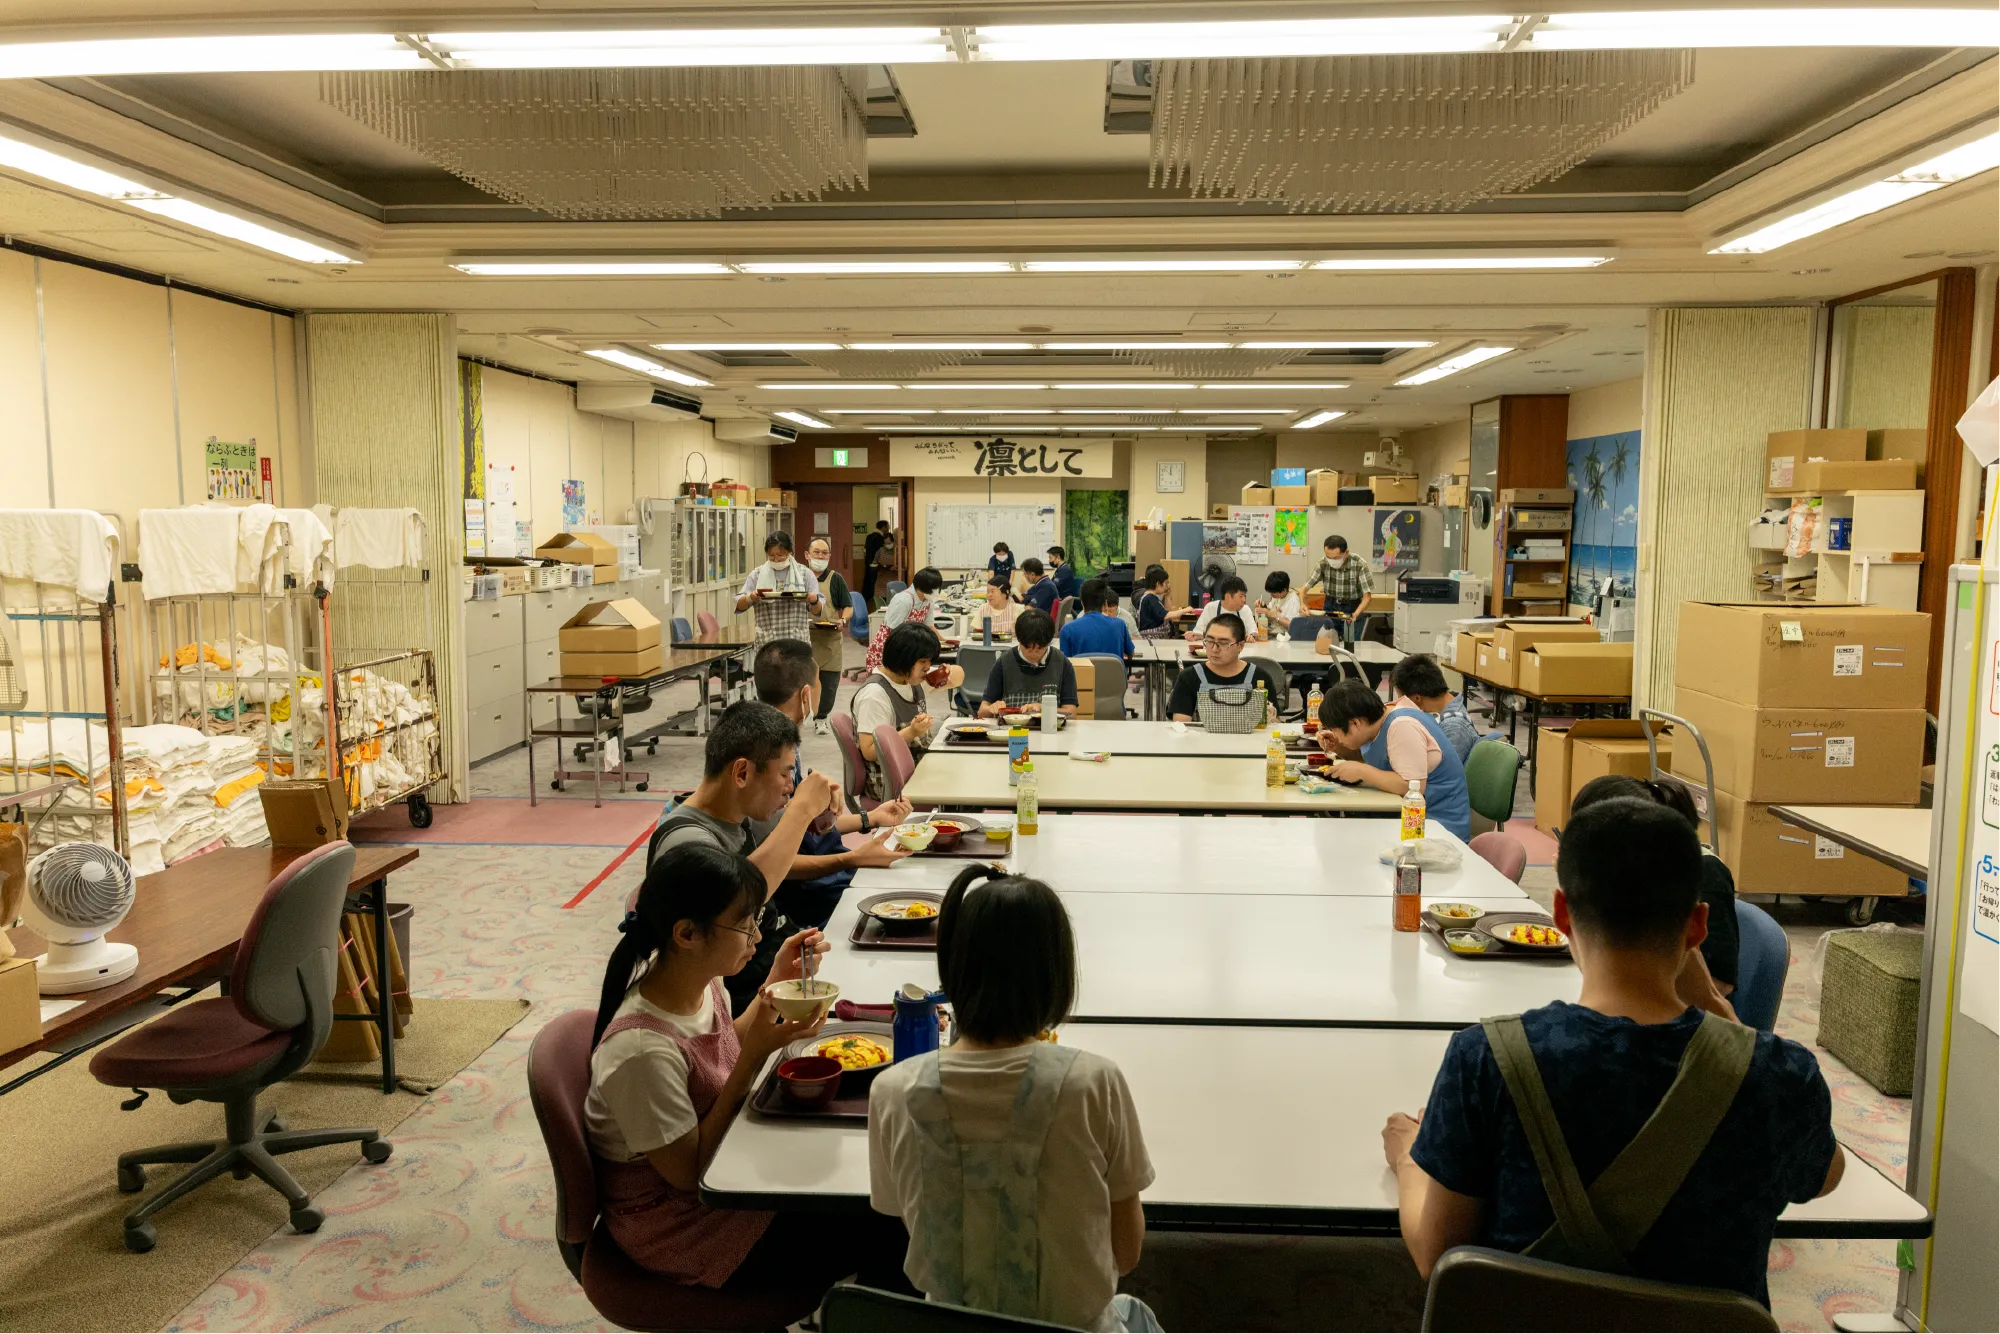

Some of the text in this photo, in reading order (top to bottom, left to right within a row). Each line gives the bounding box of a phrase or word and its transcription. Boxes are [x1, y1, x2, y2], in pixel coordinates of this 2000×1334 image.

[206, 443, 256, 457] ならぶときは
[973, 437, 1083, 476] 凛として
[212, 458, 229, 470] 一列
